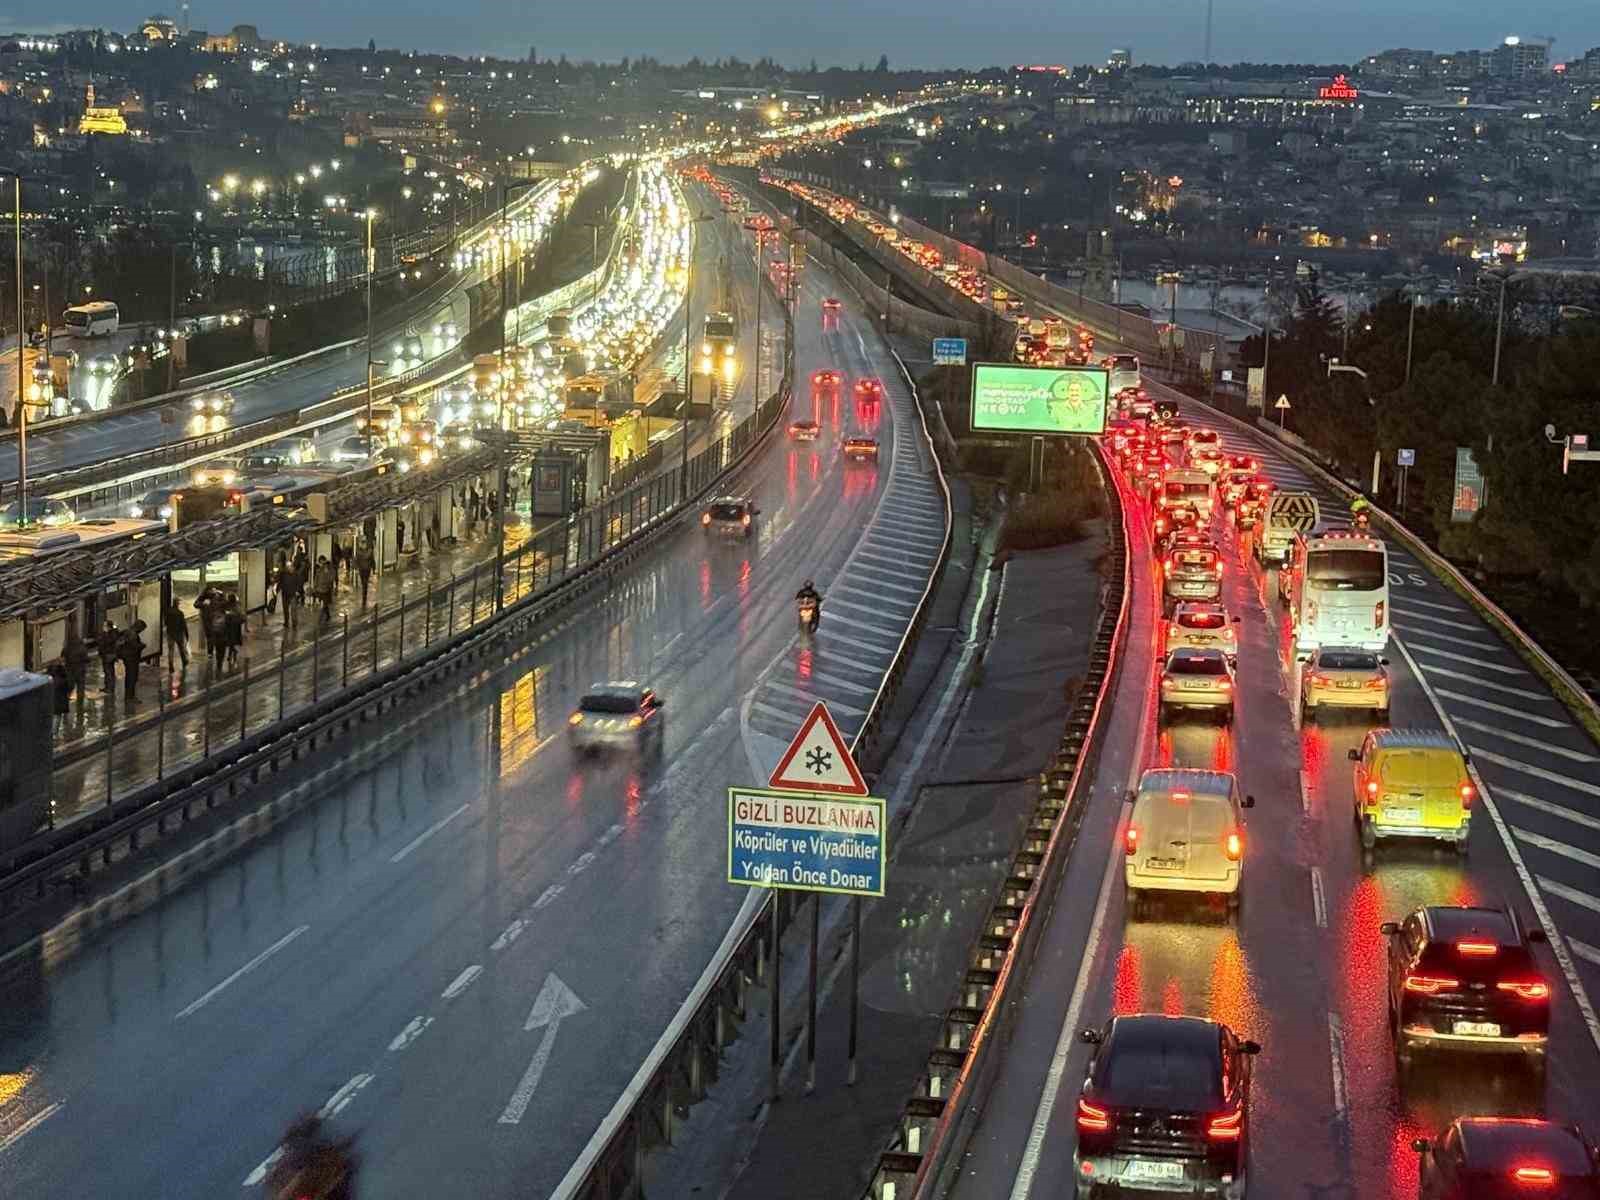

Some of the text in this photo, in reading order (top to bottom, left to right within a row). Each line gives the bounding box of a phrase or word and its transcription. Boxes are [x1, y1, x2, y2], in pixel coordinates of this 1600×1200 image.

[737, 799, 876, 829] GİZLİ BUZLANMA
[735, 830, 878, 860] Köprüler ve Viyadükler
[742, 860, 872, 889] Yoldan Önce Donar
